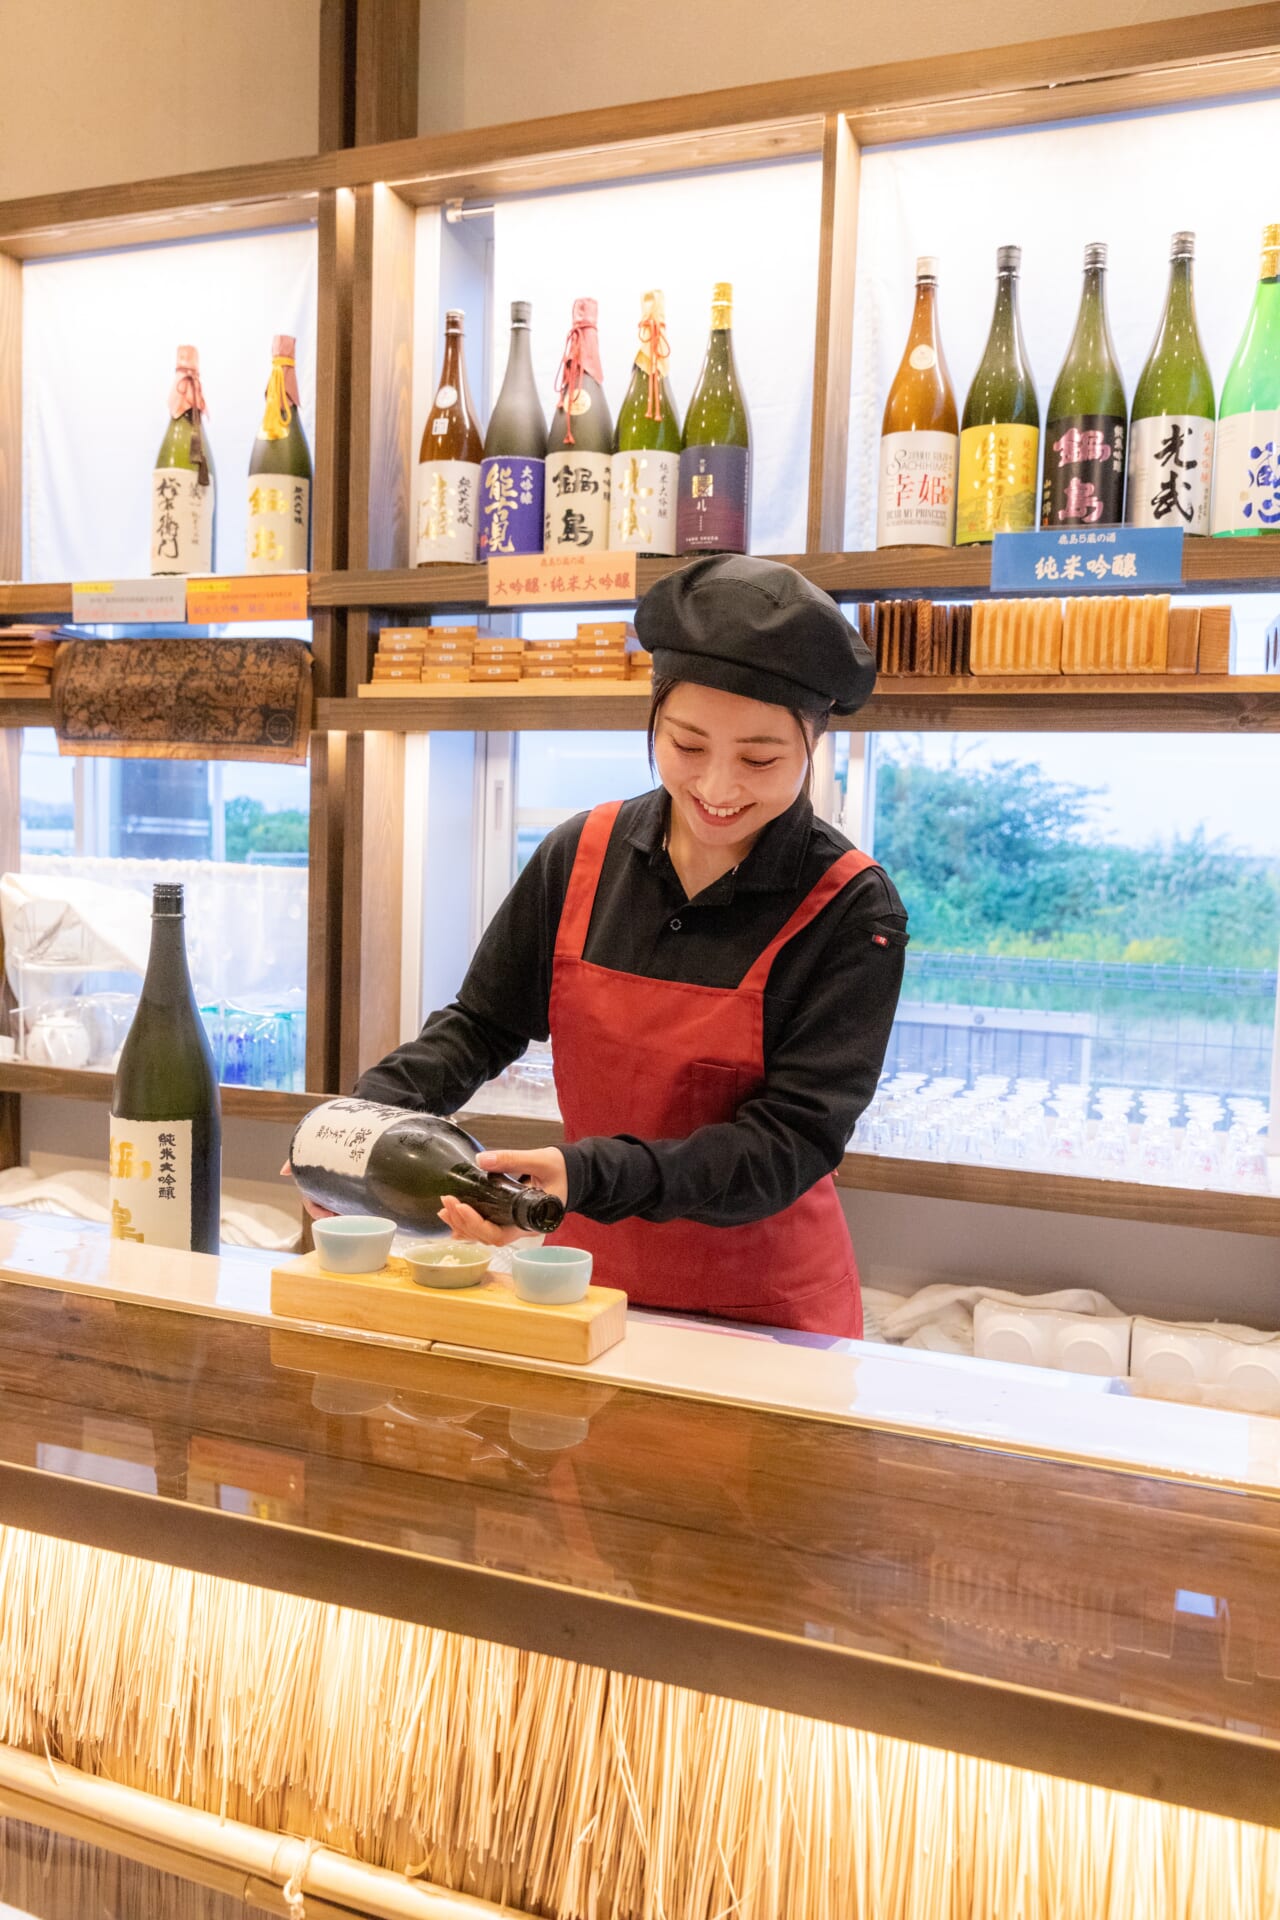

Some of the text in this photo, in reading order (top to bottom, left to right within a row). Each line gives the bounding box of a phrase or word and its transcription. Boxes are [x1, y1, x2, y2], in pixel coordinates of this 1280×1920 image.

[485, 463, 518, 552] 能古見
[520, 465, 534, 505] 大吟醸
[552, 465, 599, 546] 鍋島
[1053, 427, 1111, 523] 鍋島
[1151, 424, 1198, 523] 光武
[249, 486, 289, 561] 鍋島
[1058, 532, 1116, 544] 鹿島5蔵の酒
[1034, 552, 1138, 580] 純米吟醸
[158, 1133, 176, 1200] 純米大吟醸
